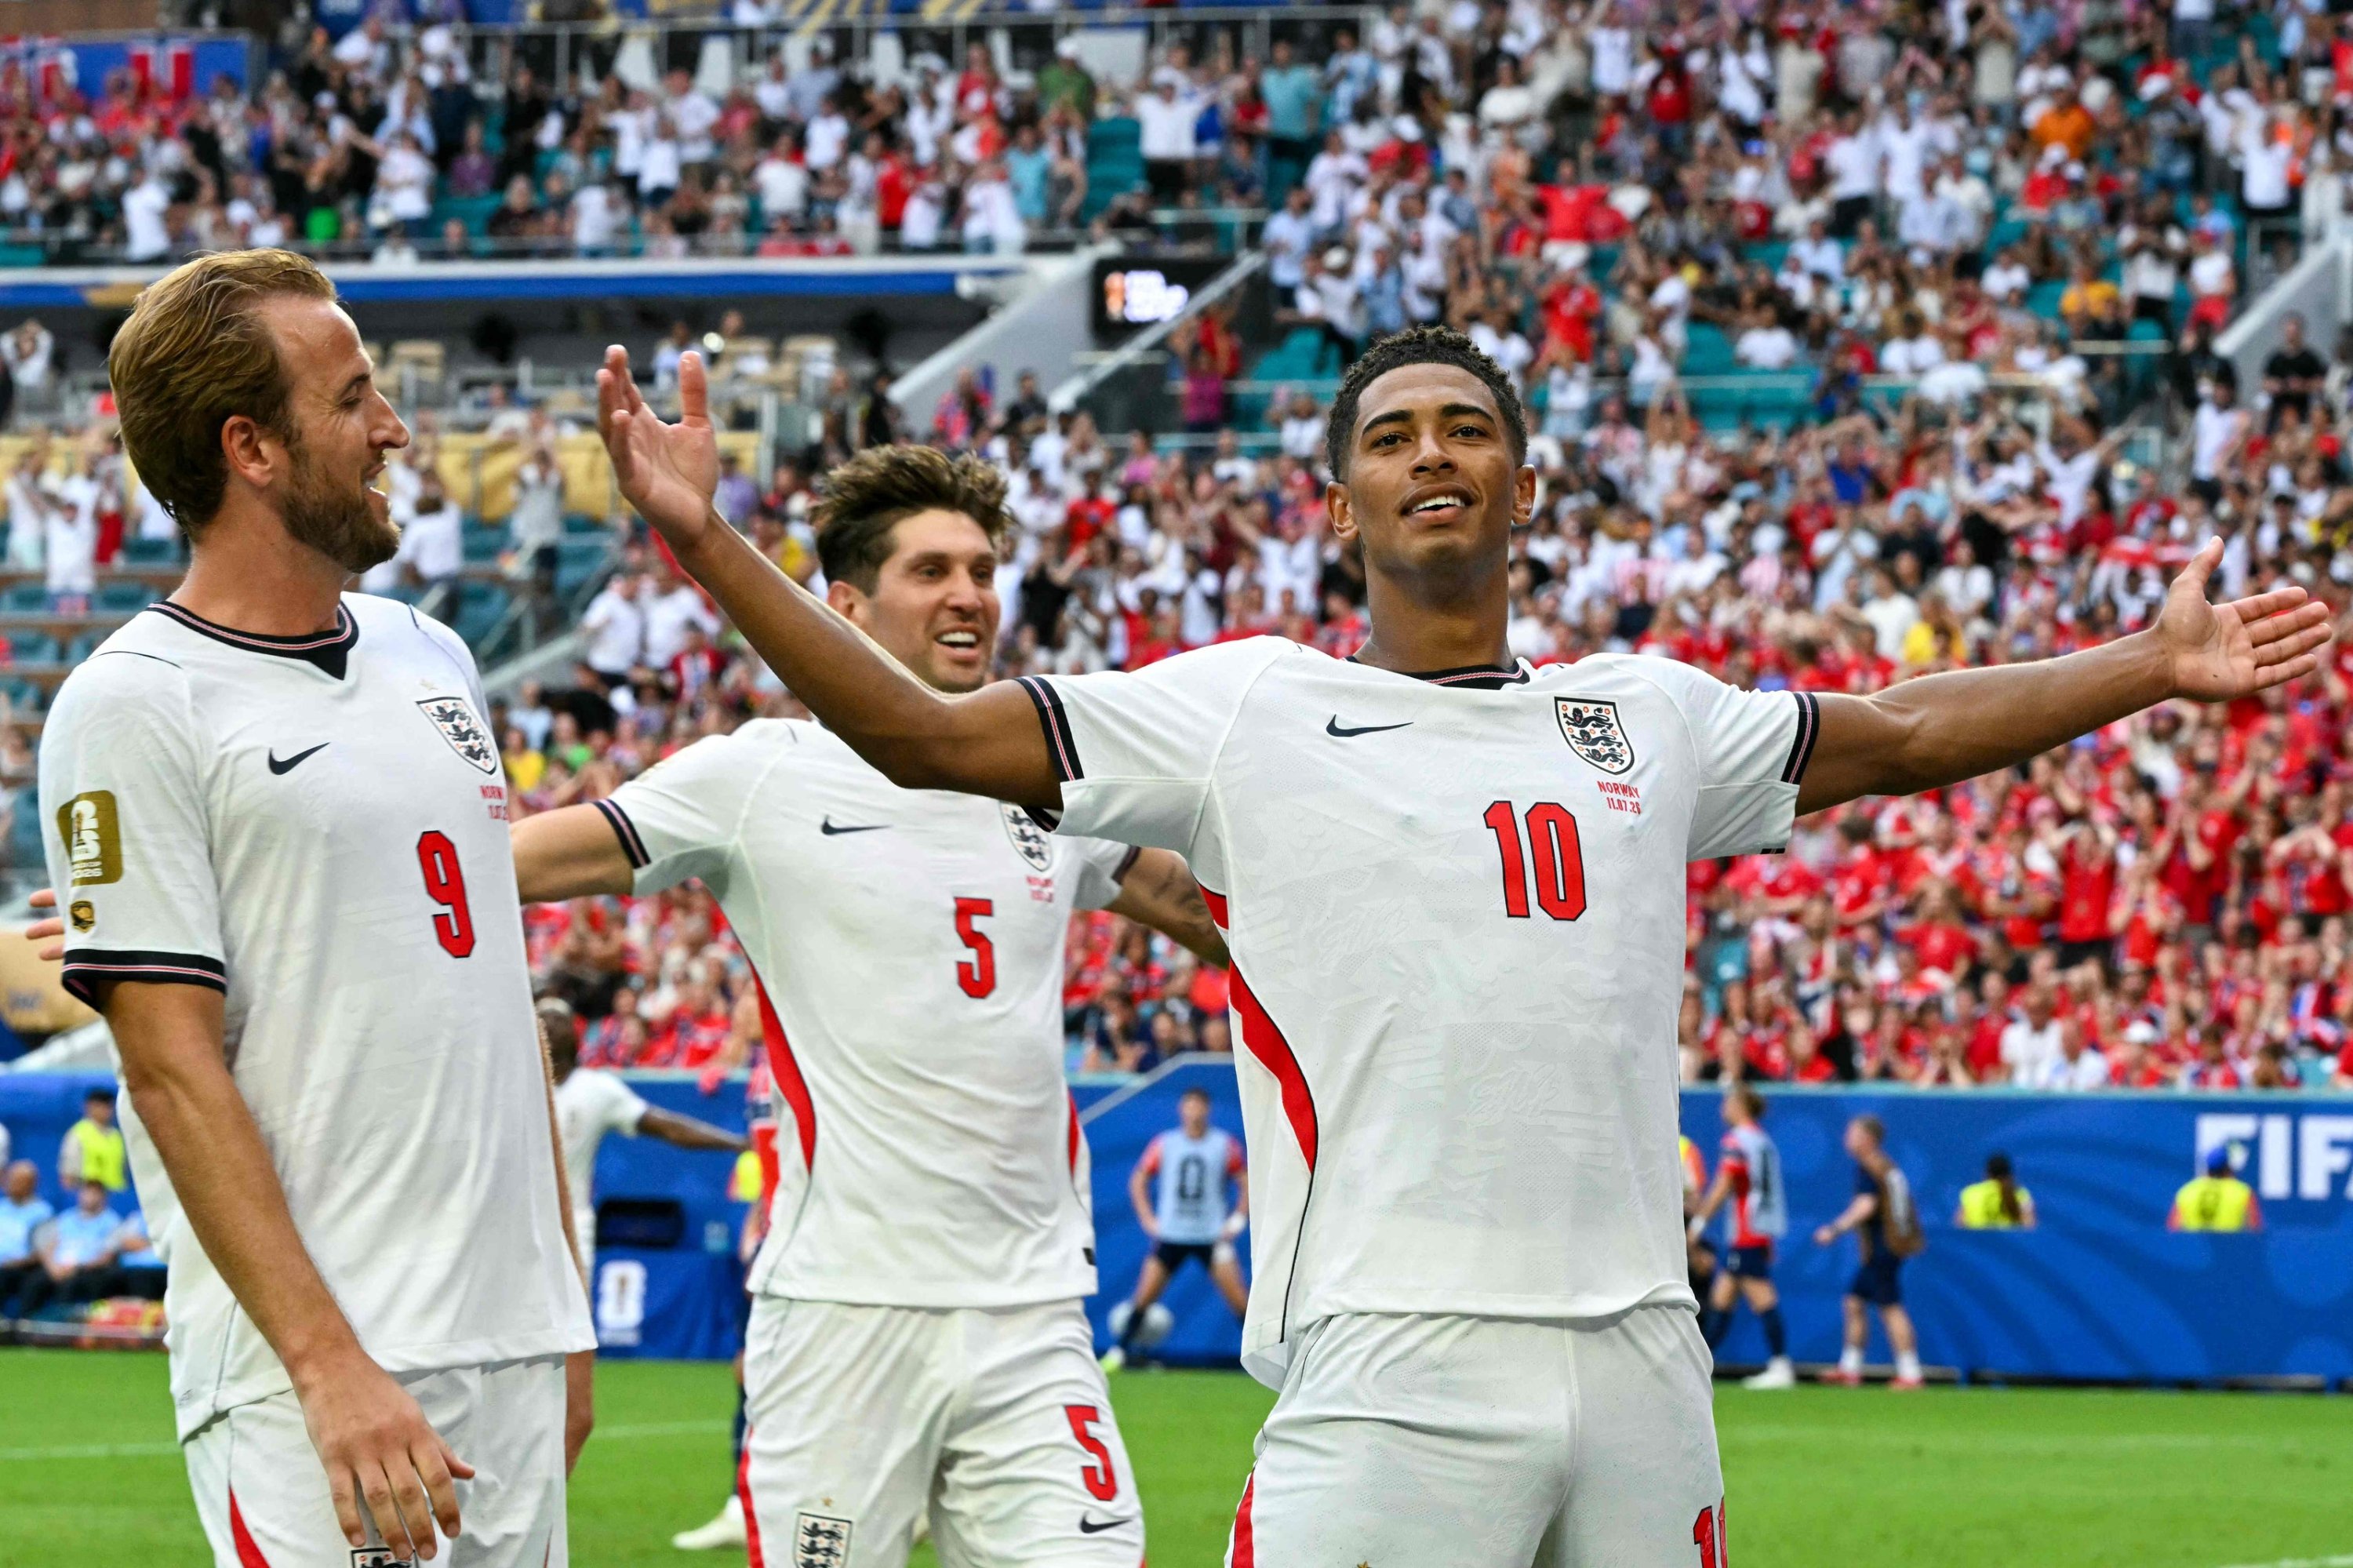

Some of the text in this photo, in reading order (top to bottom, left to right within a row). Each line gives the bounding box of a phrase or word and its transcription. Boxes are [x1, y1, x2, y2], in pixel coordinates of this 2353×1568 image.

[1597, 780, 1640, 799] NORWAY
[1606, 797, 1641, 815] 11.07.26
[416, 830, 476, 959] 9
[1483, 801, 1587, 922] 10
[953, 897, 996, 999] 5
[2196, 1113, 2353, 1201] FIF
[1063, 1405, 1118, 1501] 5
[1693, 1495, 1728, 1568] 1
